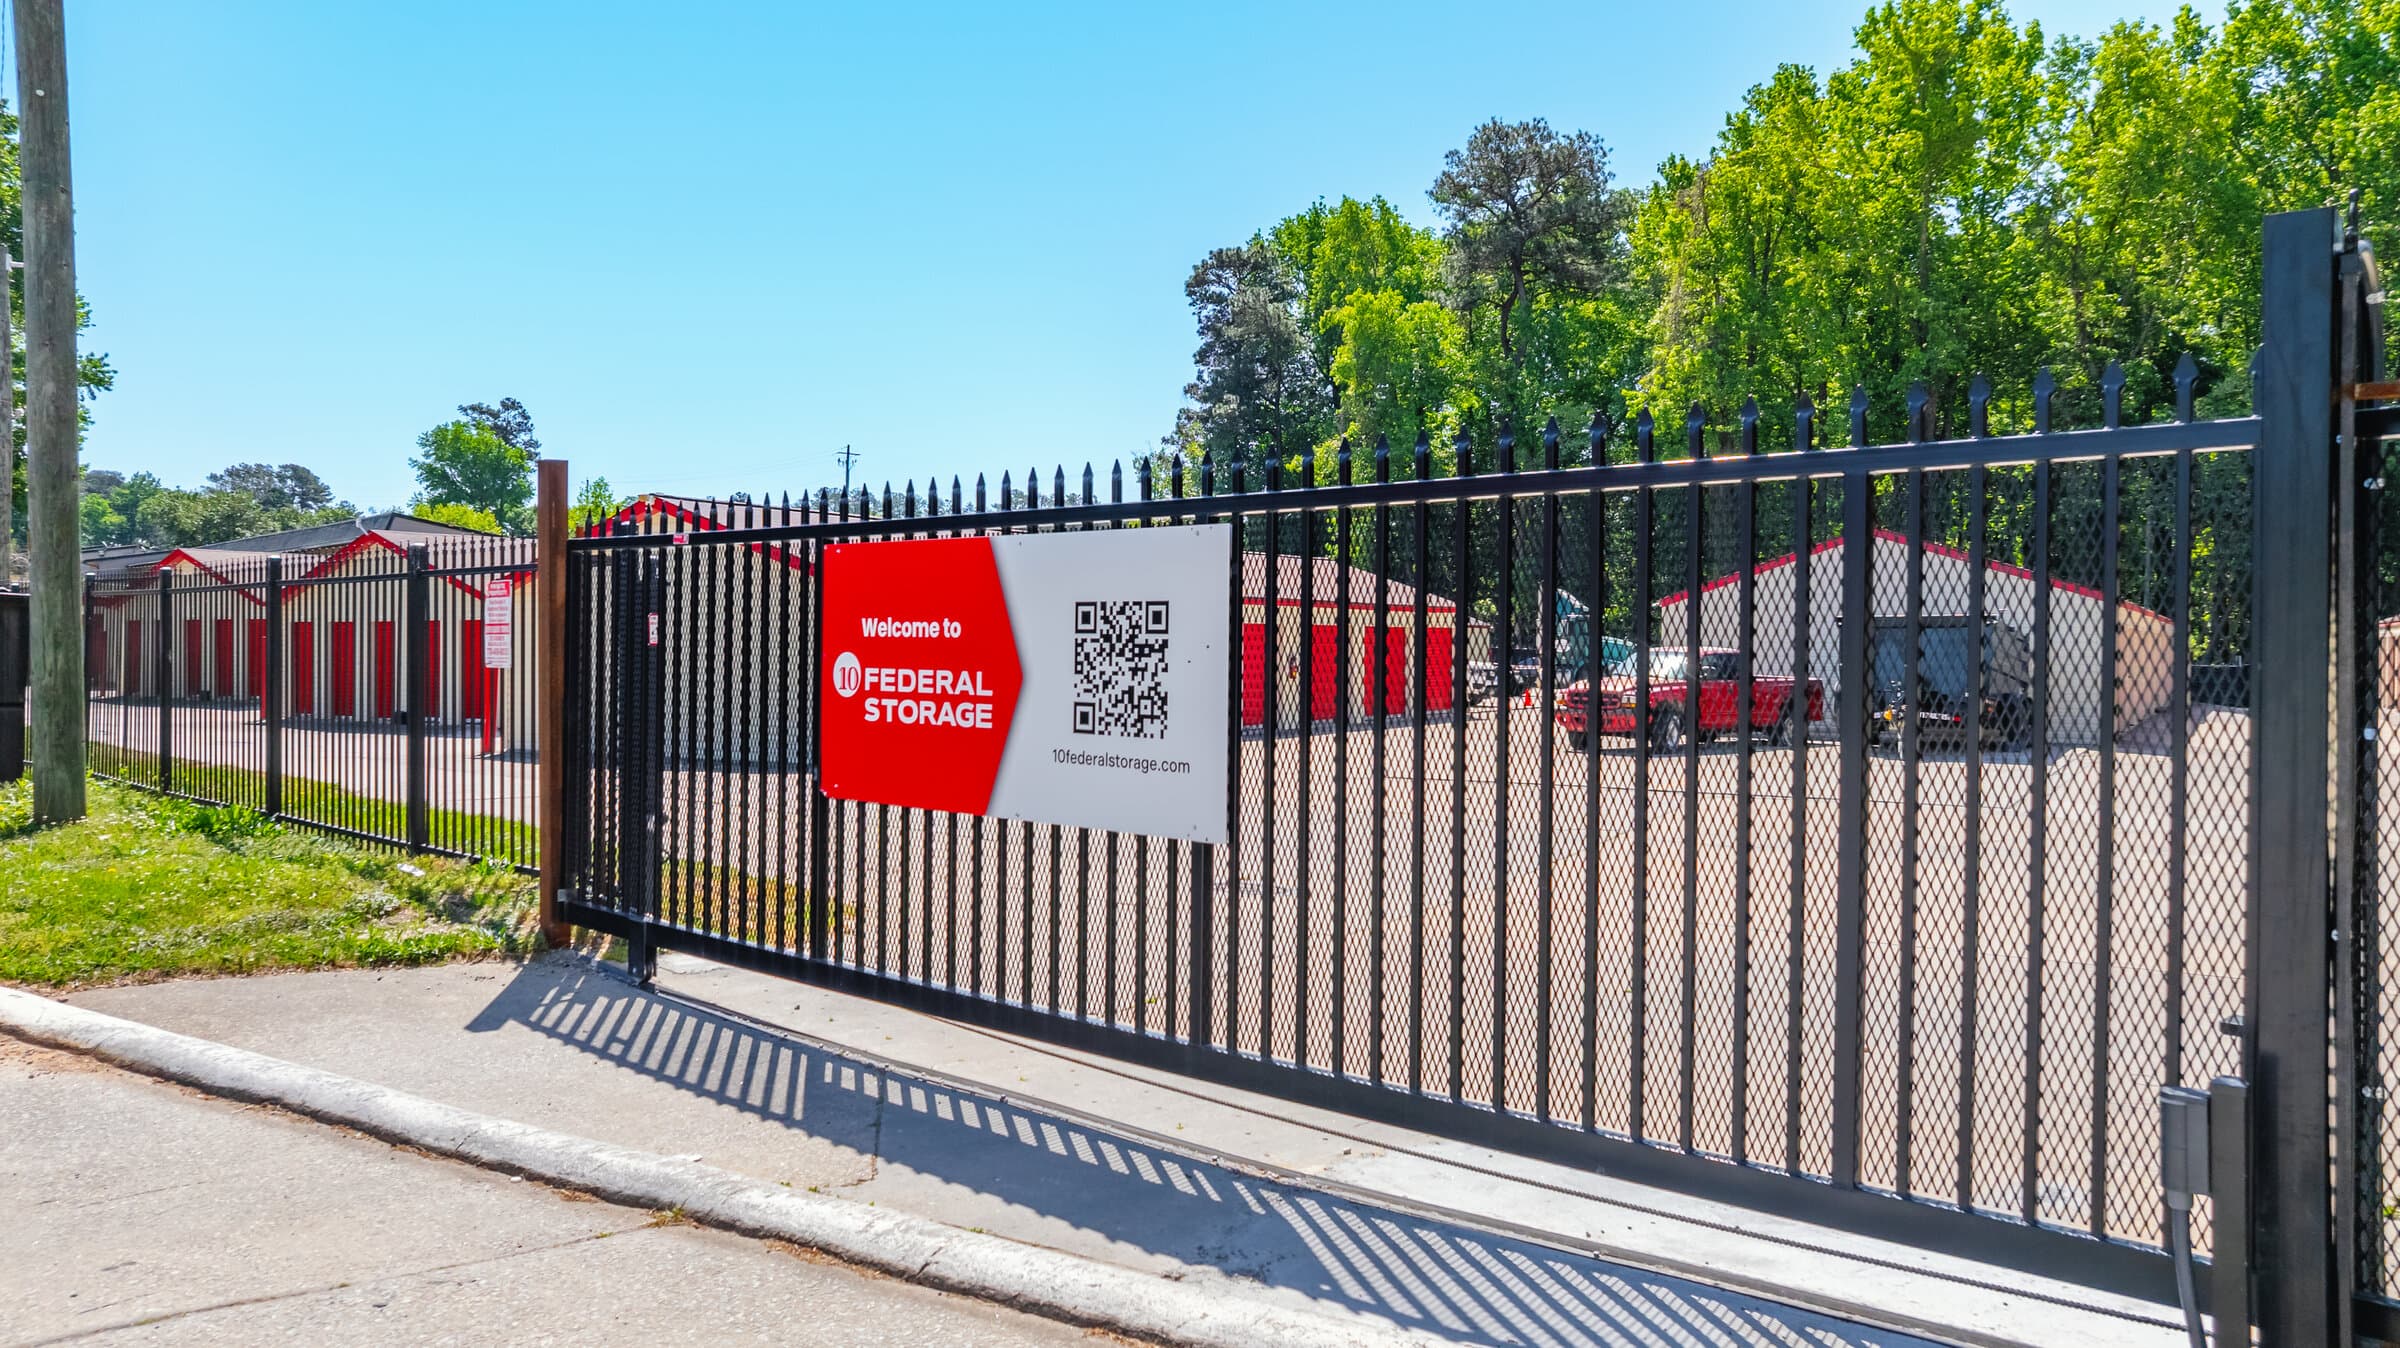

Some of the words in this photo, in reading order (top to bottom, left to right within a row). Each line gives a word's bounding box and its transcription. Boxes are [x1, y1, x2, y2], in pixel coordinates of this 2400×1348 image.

[861, 617, 940, 638] Welcome
[943, 618, 962, 638] to
[838, 666, 859, 691] 10
[864, 667, 994, 697] FEDERAL
[864, 697, 993, 729] STORAGE
[1052, 749, 1191, 774] 10federalstorage.com
